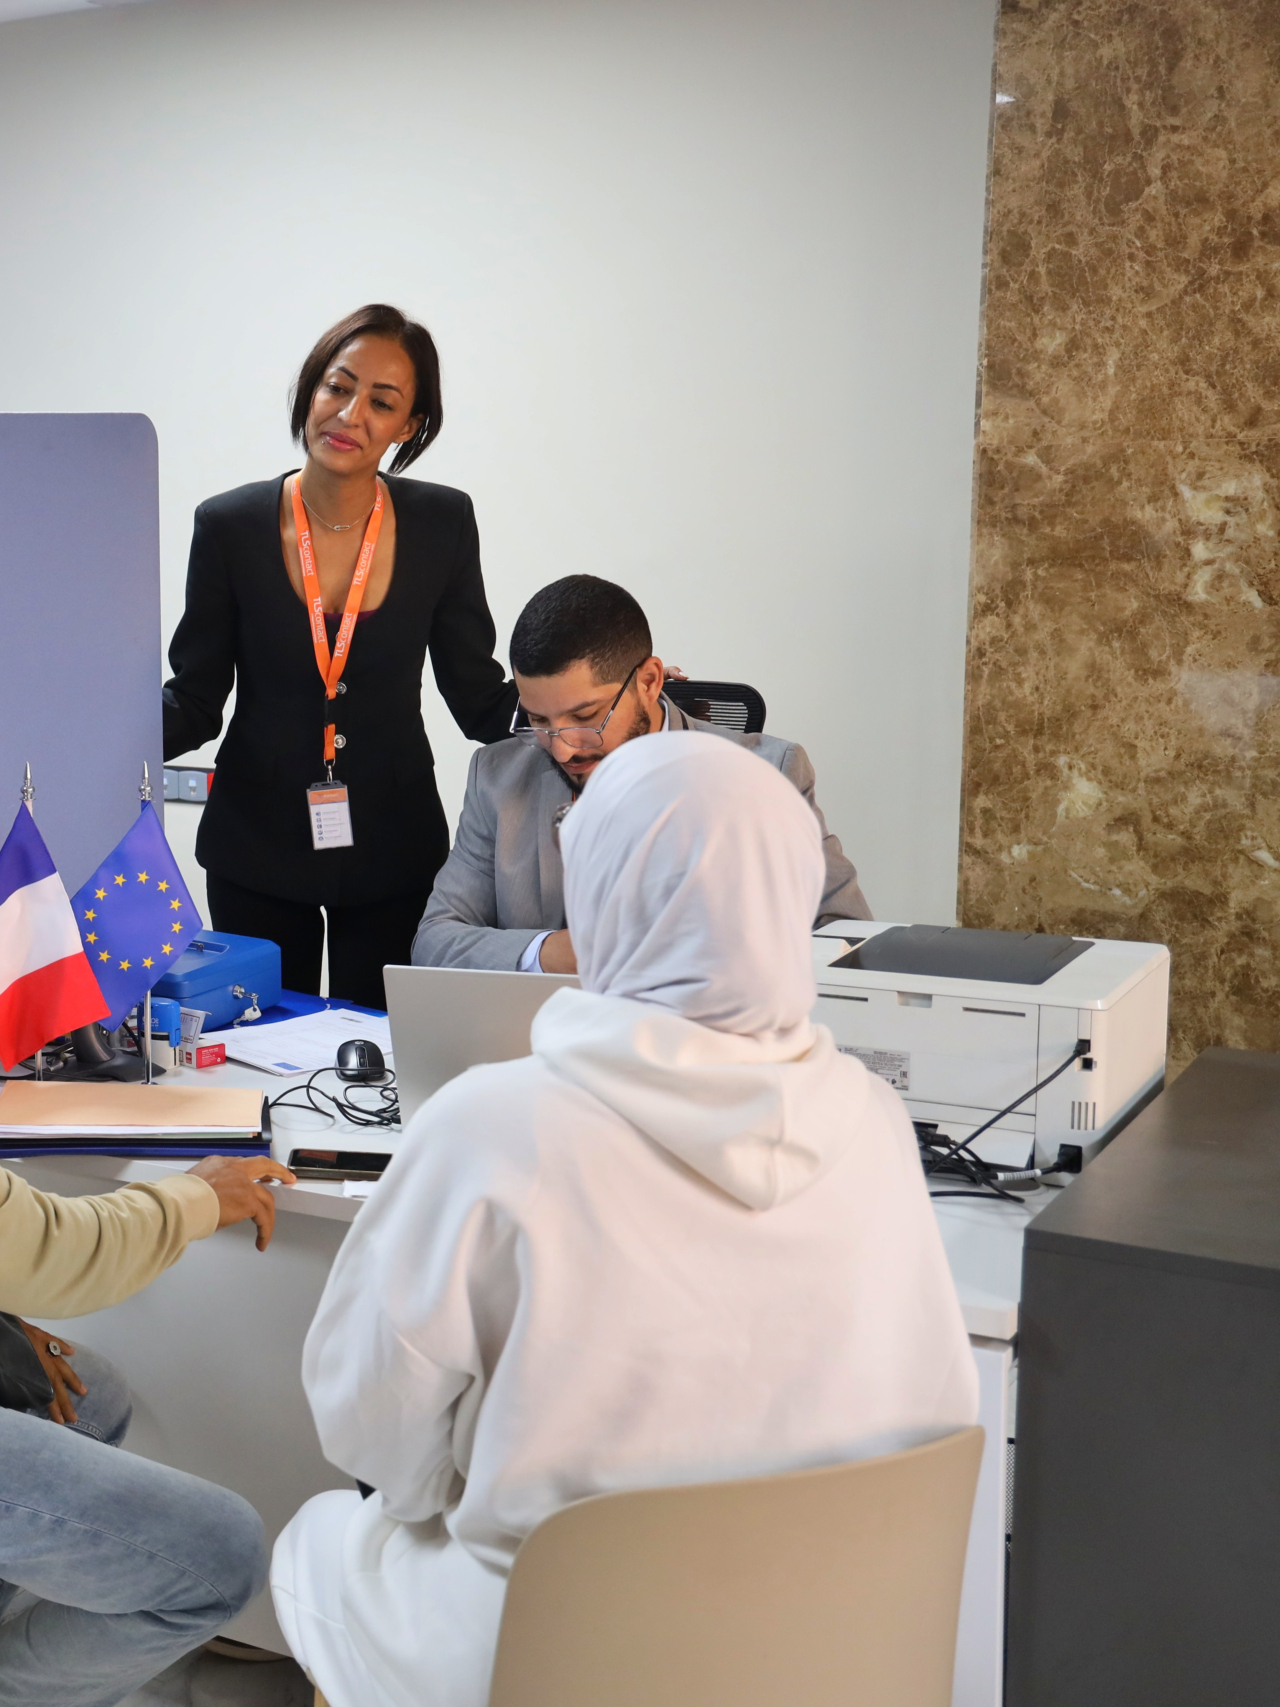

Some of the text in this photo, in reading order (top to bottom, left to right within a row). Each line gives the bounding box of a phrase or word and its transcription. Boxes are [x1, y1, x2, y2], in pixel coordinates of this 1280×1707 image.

[300, 530, 314, 576] TLScontact
[353, 541, 371, 585] TLScontact
[313, 596, 326, 643] TLScontact
[334, 612, 352, 658] TLScontact
